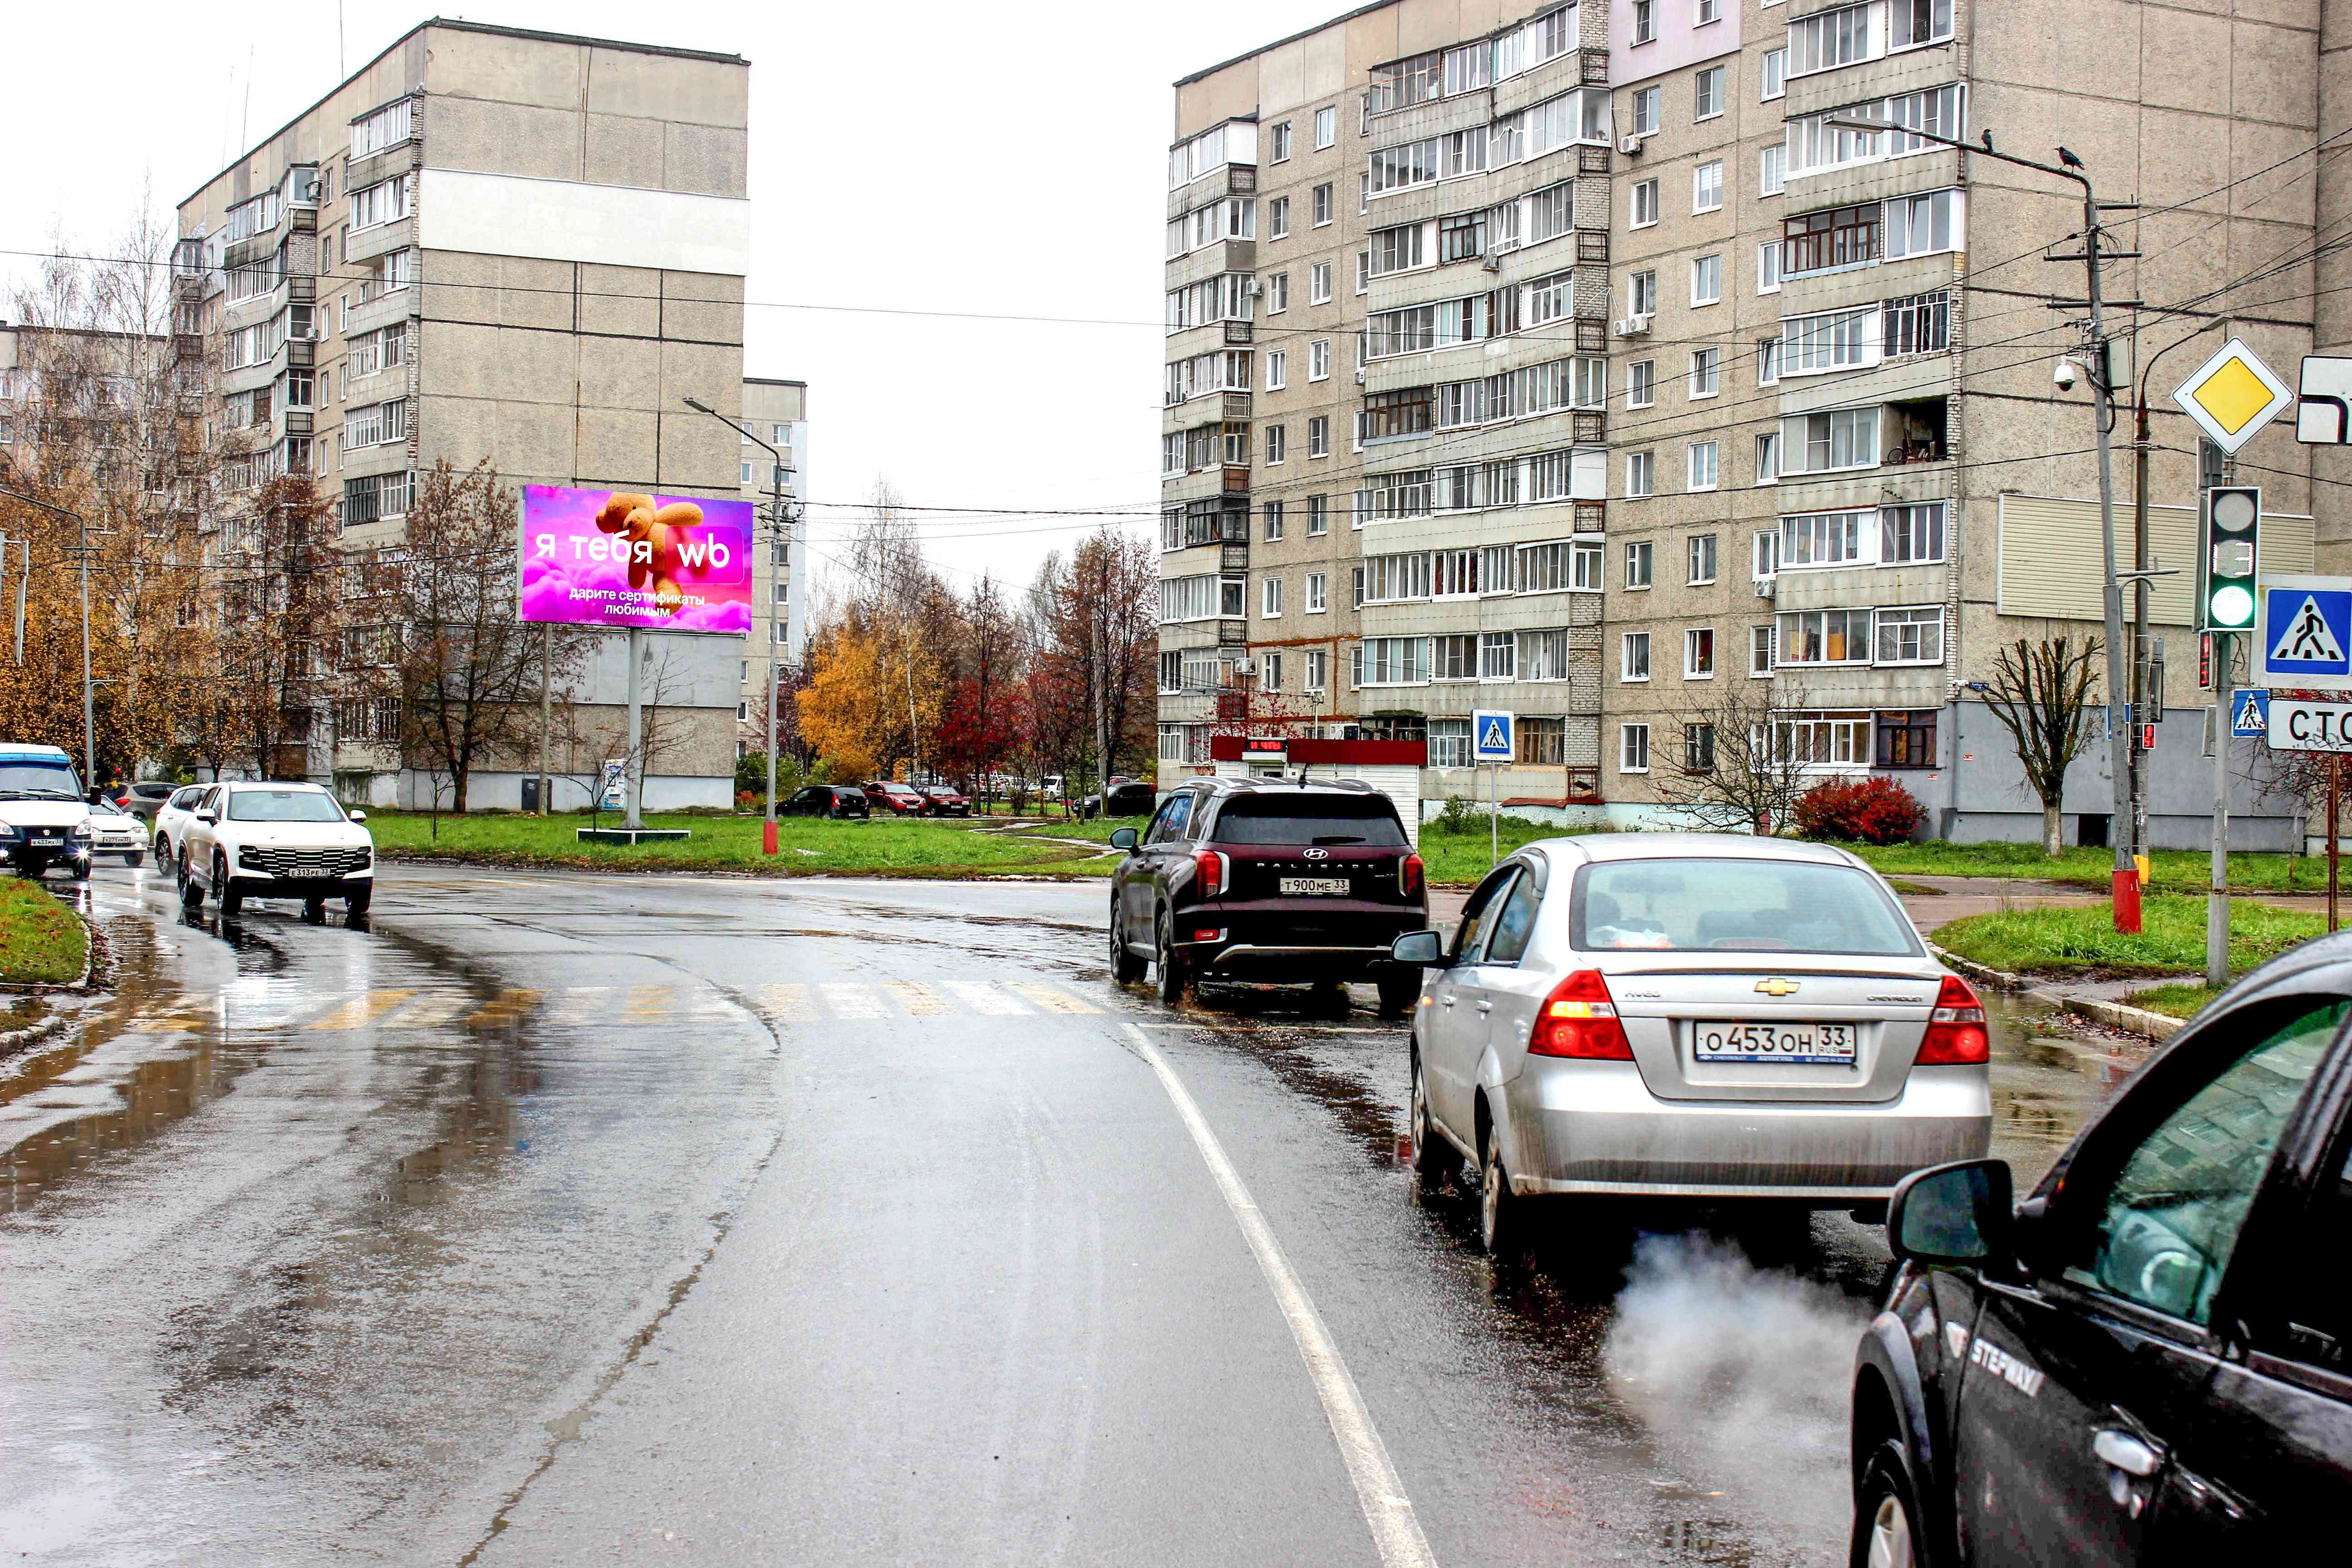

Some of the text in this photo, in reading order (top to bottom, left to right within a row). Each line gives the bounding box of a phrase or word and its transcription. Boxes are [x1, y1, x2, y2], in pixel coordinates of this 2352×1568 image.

[536, 529, 652, 564] я тебя
[676, 533, 730, 568] wb
[569, 588, 705, 605] дарите сертификаты
[604, 603, 670, 617] любимым
